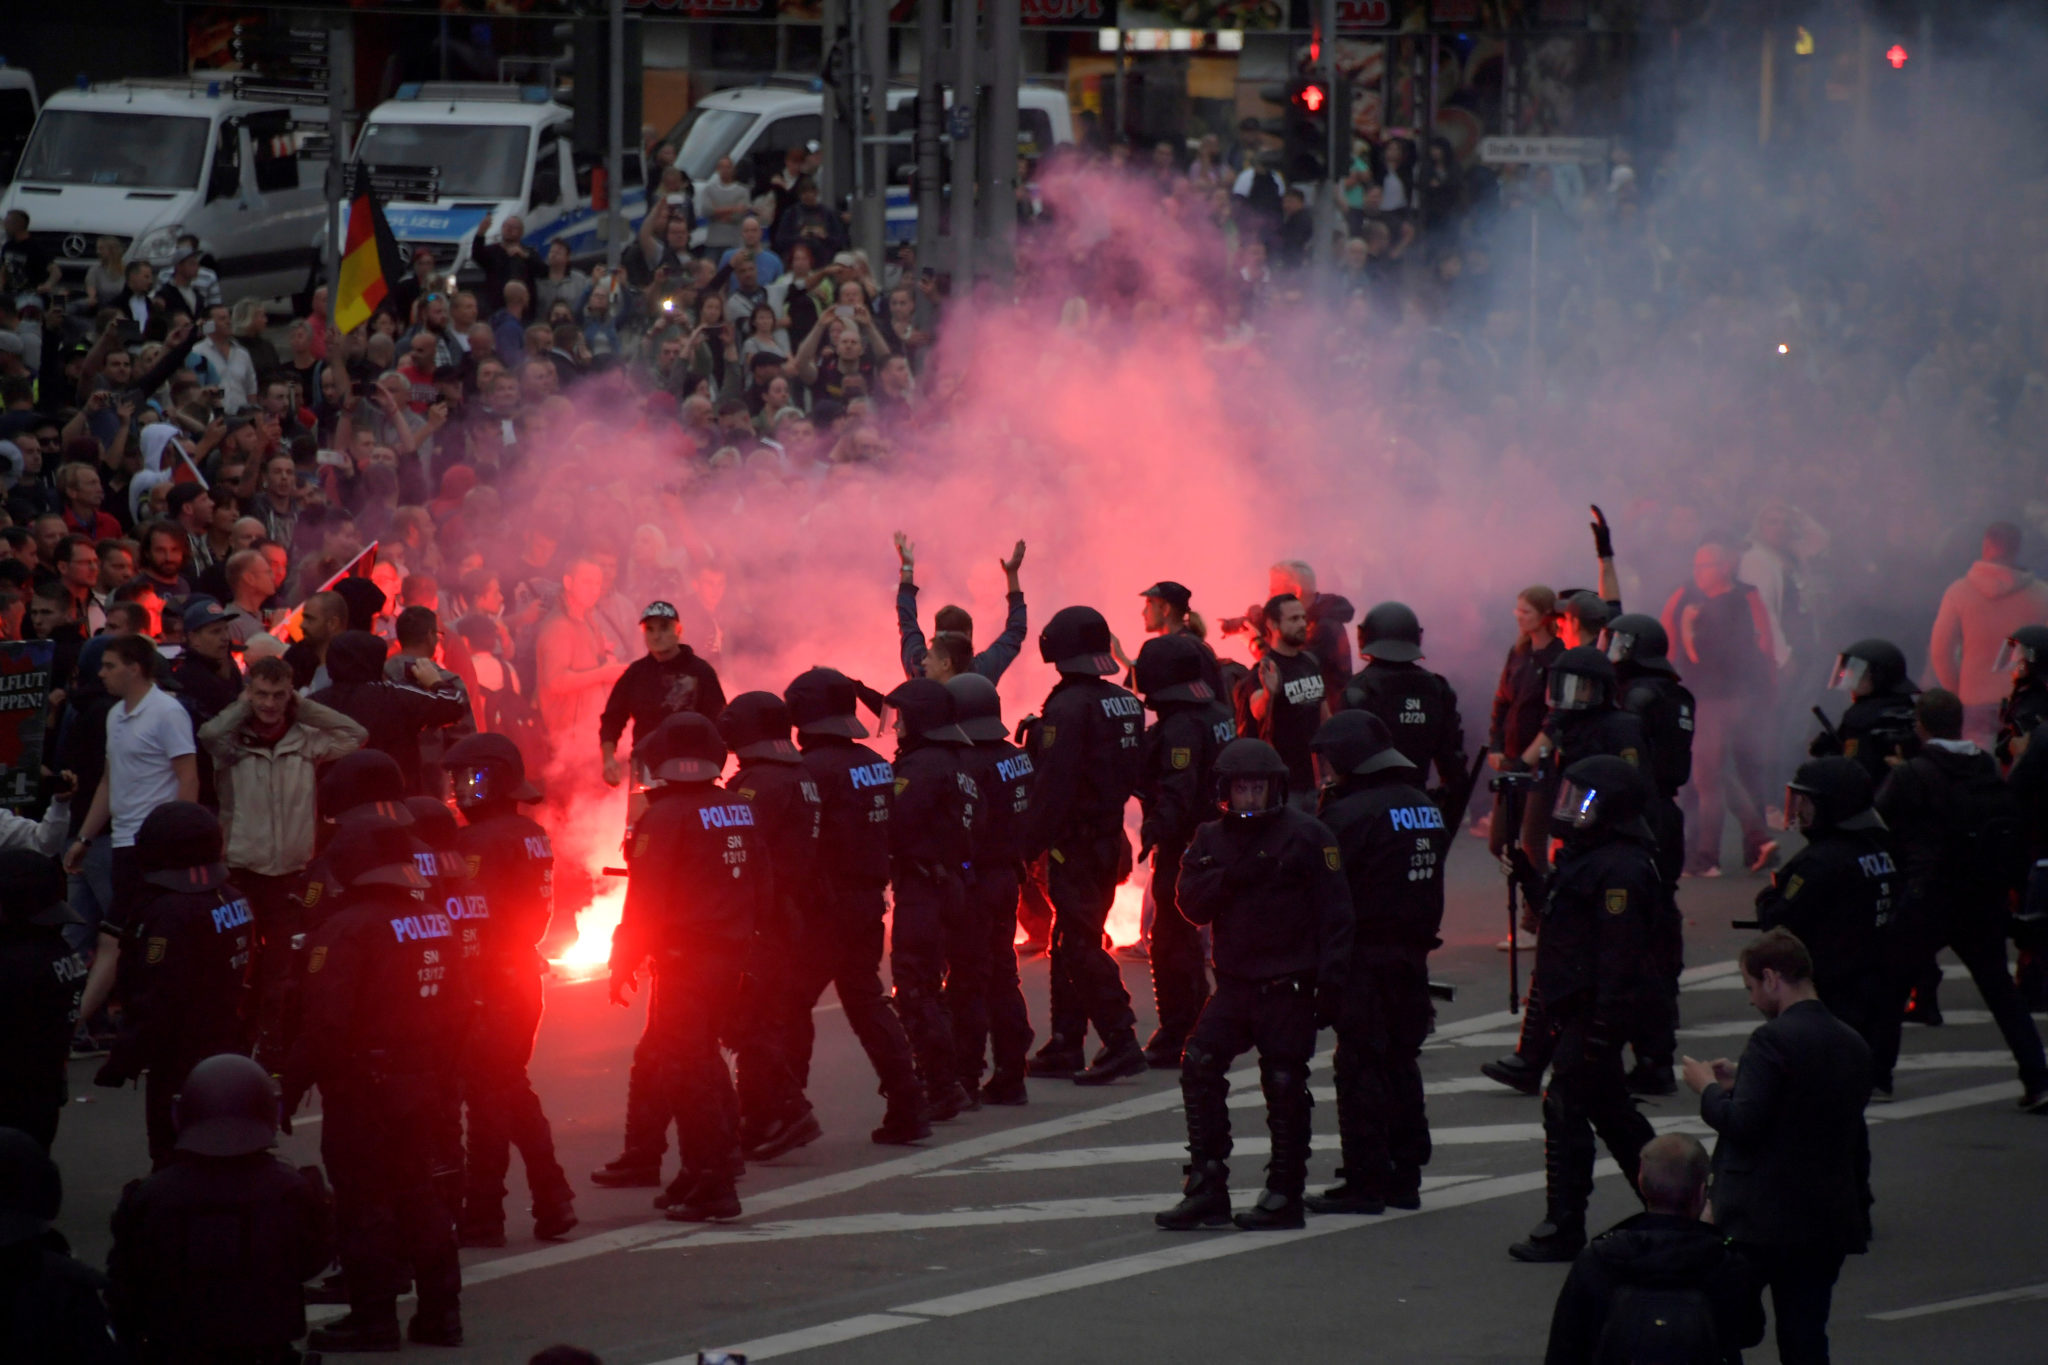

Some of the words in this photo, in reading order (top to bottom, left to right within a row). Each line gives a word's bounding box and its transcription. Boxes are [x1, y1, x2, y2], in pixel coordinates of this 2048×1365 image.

[1405, 698, 1421, 711] SN
[698, 804, 756, 830] POLIZEI
[1390, 806, 1445, 832] POLIZEI
[727, 835, 742, 849] SN
[1415, 838, 1431, 851] SN
[423, 950, 439, 965] SN
